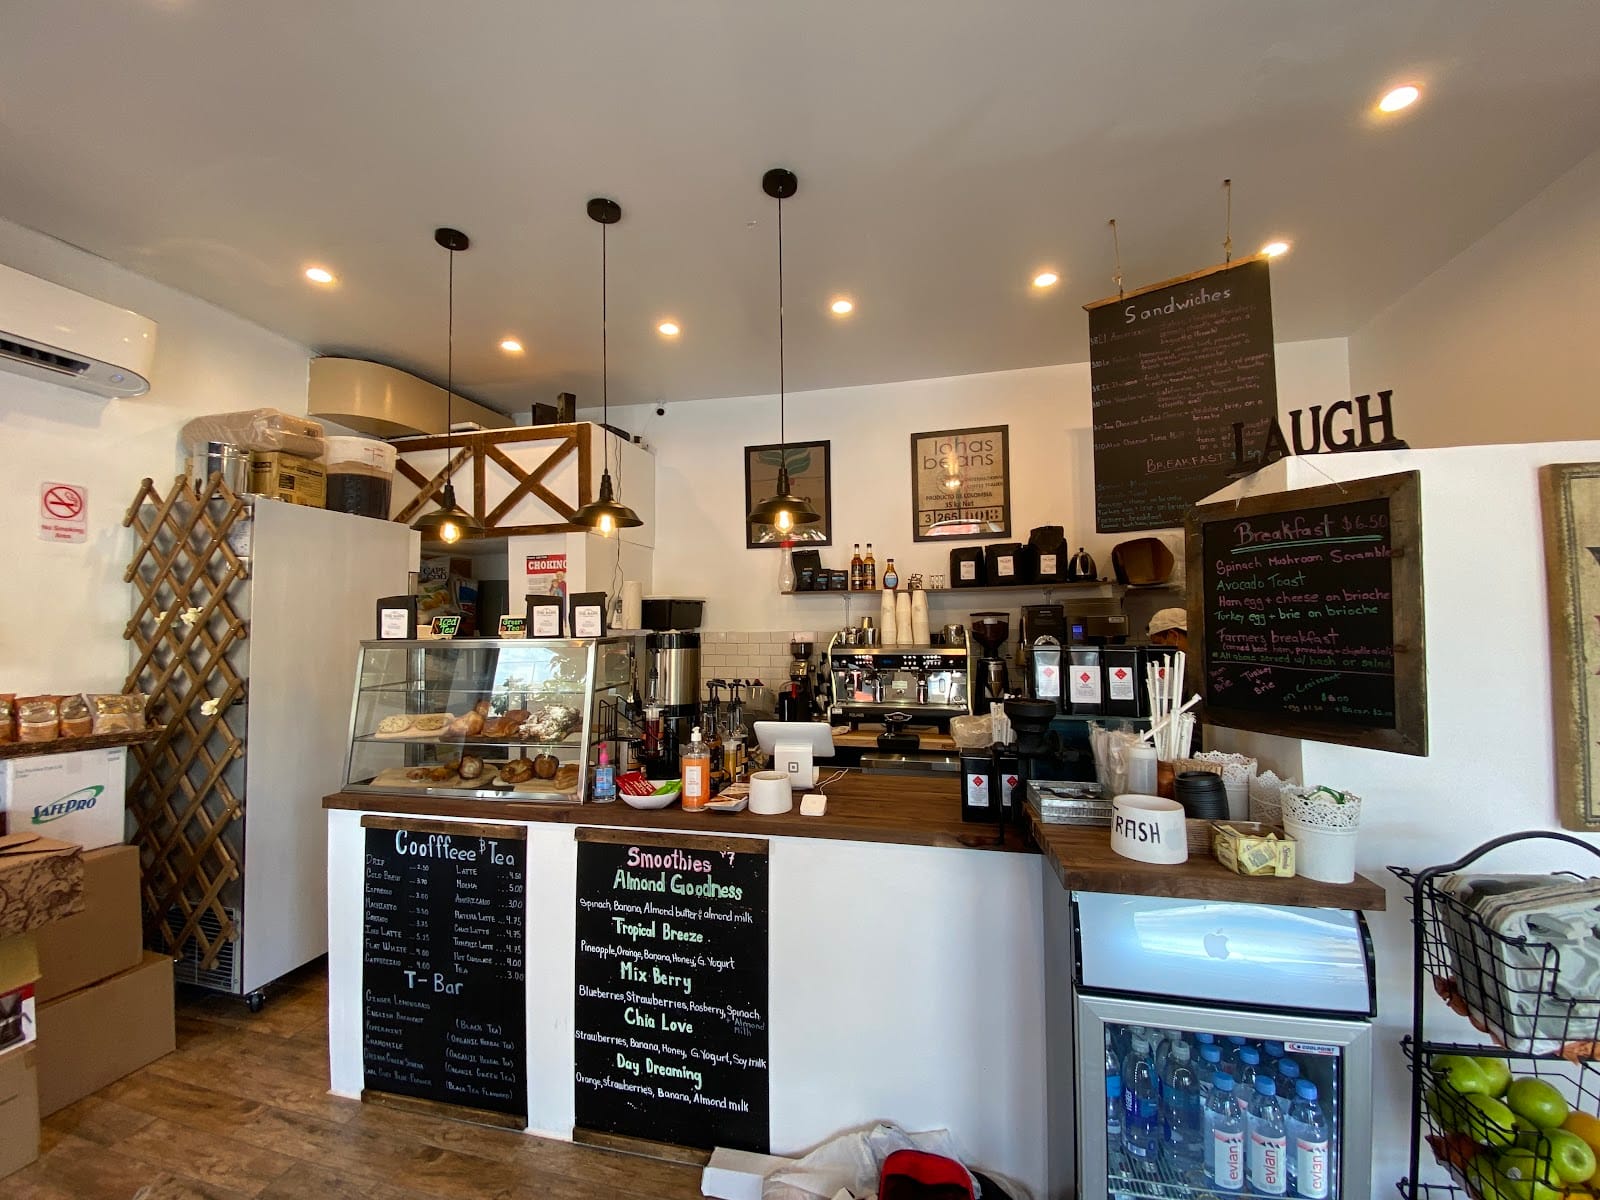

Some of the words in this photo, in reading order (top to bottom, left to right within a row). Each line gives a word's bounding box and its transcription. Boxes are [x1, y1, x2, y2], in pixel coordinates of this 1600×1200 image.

[1125, 287, 1232, 324] Sandwiches
[1231, 390, 1395, 466] LAUGH
[1146, 453, 1225, 473] BREAKFAST
[924, 513, 931, 523] 3
[937, 512, 957, 522] 265
[1233, 514, 1334, 546] Breakfast
[1342, 514, 1388, 533] $6.50
[1216, 556, 1262, 576] Spinach
[1268, 552, 1323, 567] Mushroom
[1216, 574, 1264, 591] Avocado
[1268, 571, 1306, 587] Toast
[1219, 595, 1242, 607] Ham
[1244, 598, 1265, 610] egg
[1275, 591, 1319, 605] cheese
[1326, 593, 1341, 602] on
[1342, 588, 1391, 601] brioche
[1214, 610, 1245, 625] Turkey
[1248, 613, 1267, 626] egg
[1279, 608, 1300, 620] brie
[1308, 610, 1322, 619] on
[1325, 604, 1379, 616] brioche
[1216, 627, 1266, 643] Farmers
[1271, 627, 1340, 645] breakfast
[1259, 652, 1290, 663] served
[1309, 654, 1337, 667] hash
[1343, 658, 1357, 667] or
[488, 840, 515, 866] Tea
[626, 847, 712, 873] Smoothies
[456, 864, 478, 876] LATTE
[612, 869, 666, 892] Almond
[670, 873, 744, 901] Goodness
[579, 898, 613, 912] Spinach,
[613, 900, 643, 915] Banana,
[643, 901, 674, 918] Almond
[675, 906, 697, 920] butter
[703, 907, 733, 922] almond
[734, 910, 753, 924] milk
[381, 925, 403, 939] LATTE
[611, 916, 656, 943] Tropical
[662, 922, 704, 944] Breeze
[620, 960, 648, 983] Mix
[652, 967, 692, 995] Berry
[707, 956, 736, 973] Yogurt
[434, 973, 464, 996] Bar
[578, 984, 627, 1004] Blueberries,
[626, 990, 689, 1012] Strawberries,
[726, 1004, 761, 1021] Spinach
[624, 1006, 656, 1029] Chia
[661, 1012, 694, 1034] Love
[734, 1017, 766, 1031] Almond
[575, 1029, 629, 1048] Strawberries,
[629, 1037, 661, 1054] Banana,
[732, 1053, 749, 1070] Soy
[748, 1056, 767, 1070] milk
[616, 1052, 640, 1077] Day
[645, 1057, 703, 1091] Dreaming
[657, 1087, 692, 1104] Banana,
[693, 1093, 727, 1109] Almond
[728, 1098, 750, 1113] milk
[1229, 1144, 1239, 1180] evian
[1265, 1148, 1276, 1185] evian
[1312, 1150, 1322, 1190] evian
